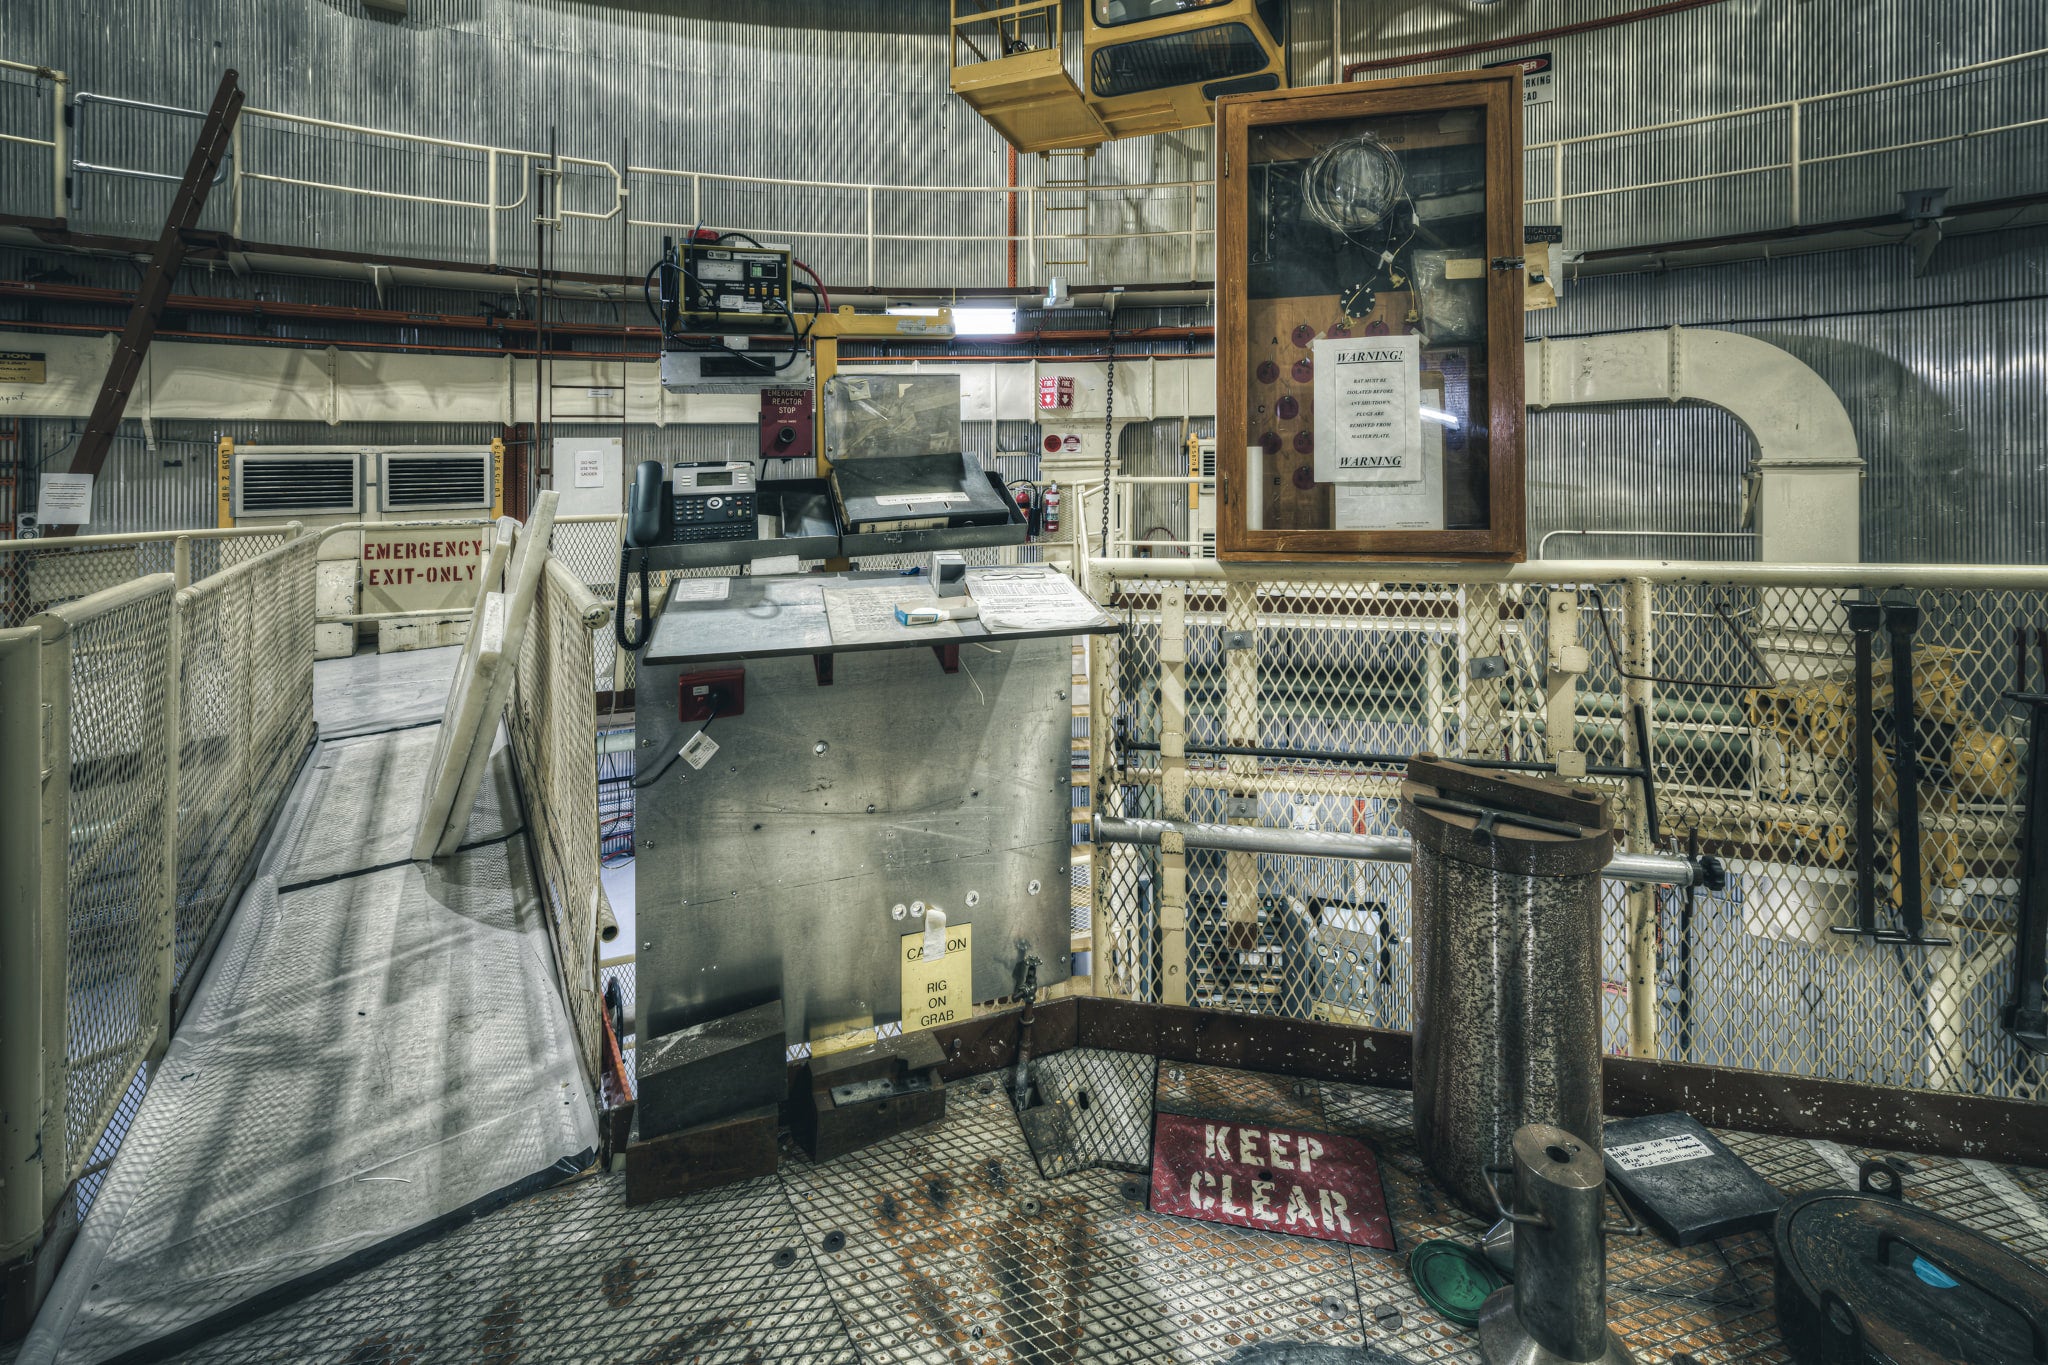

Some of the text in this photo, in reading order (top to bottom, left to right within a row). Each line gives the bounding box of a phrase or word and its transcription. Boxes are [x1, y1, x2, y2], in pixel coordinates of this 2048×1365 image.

[1519, 61, 1537, 71] ER
[1524, 75, 1551, 88] RKING
[1337, 350, 1403, 363] WARNING!
[779, 406, 796, 414] STOP
[1339, 456, 1401, 468] WARNING
[364, 540, 483, 560] EMERGENCY
[369, 565, 476, 586] EXIT-ONLY
[907, 938, 967, 960] CAON
[927, 980, 947, 993] RIG
[929, 996, 946, 1009] ON
[921, 1010, 954, 1027] GRAB
[1205, 1124, 1324, 1173] KEEP
[1189, 1171, 1352, 1234] CLEAR
